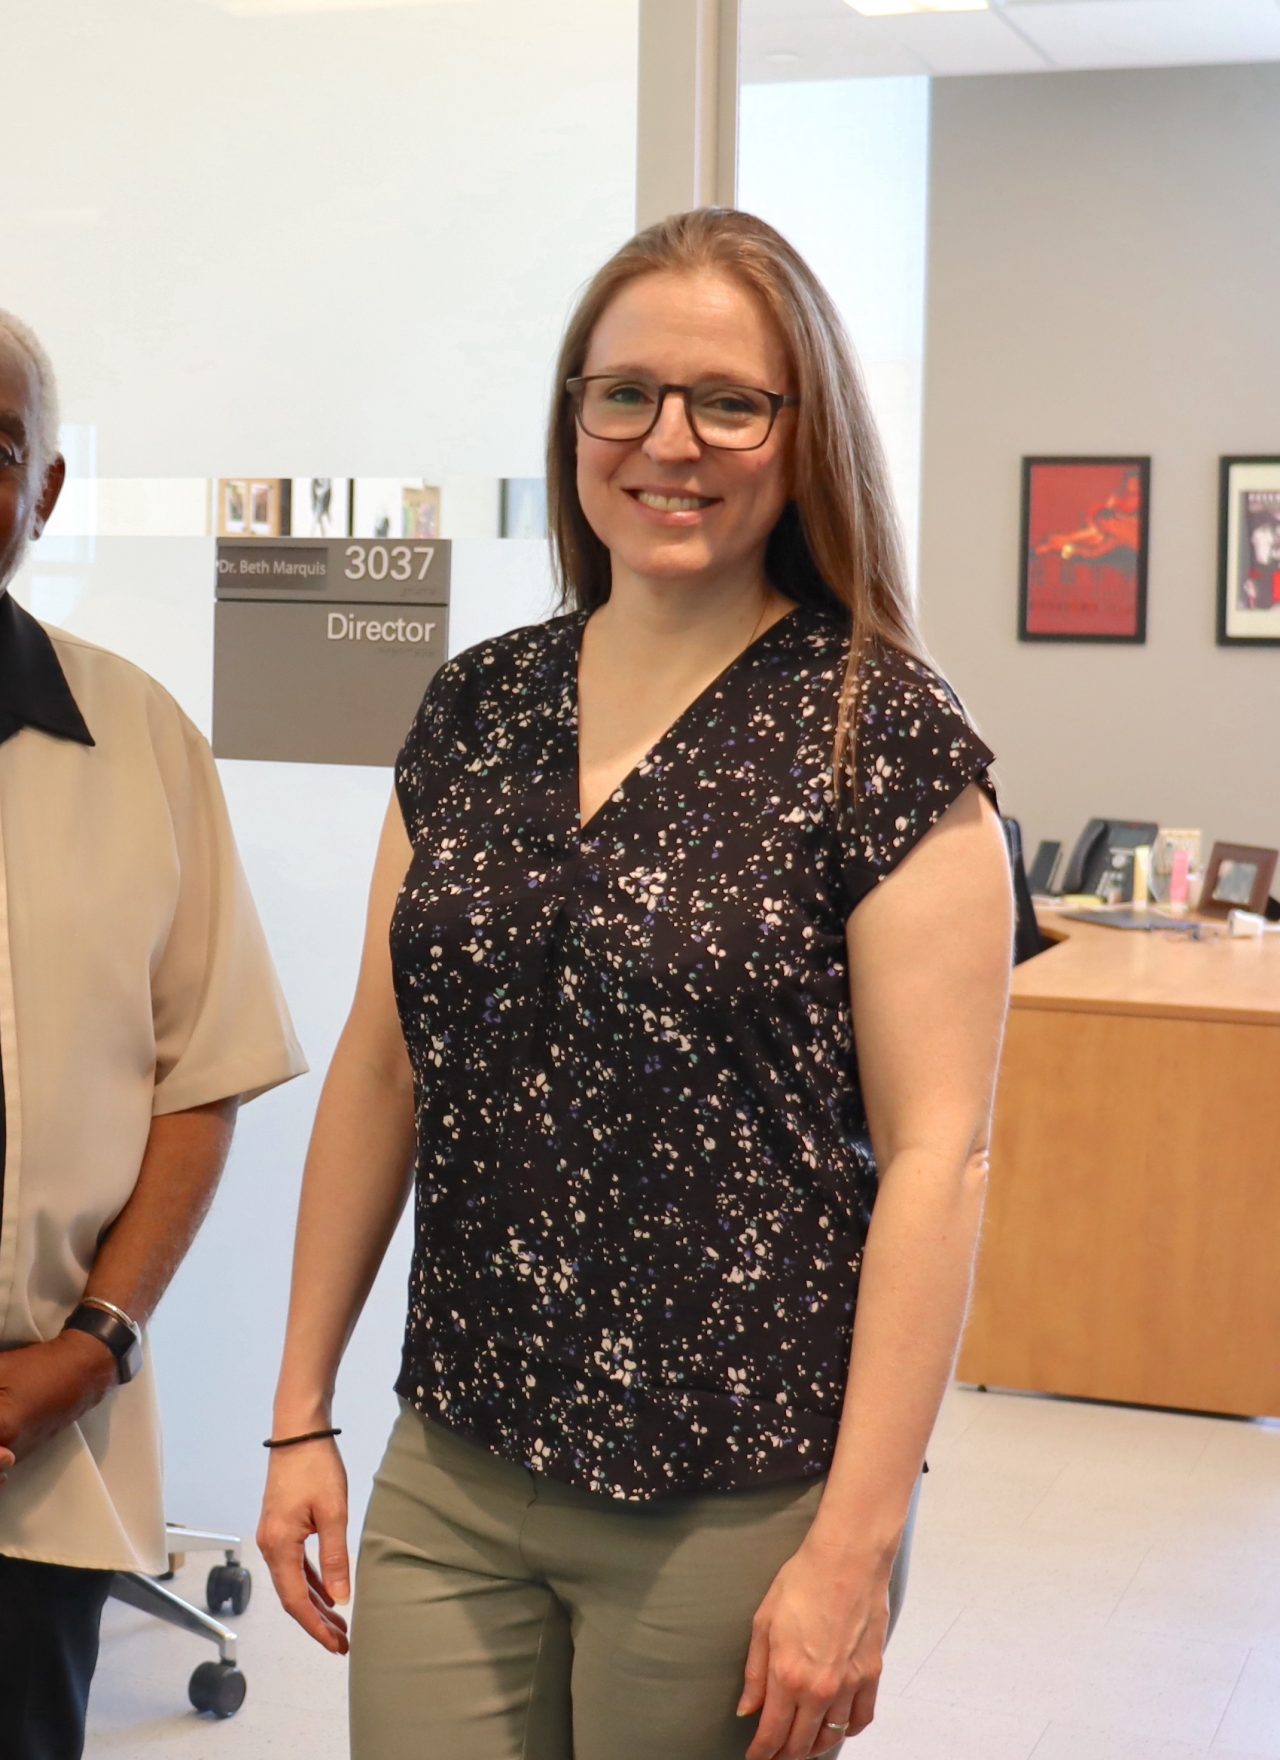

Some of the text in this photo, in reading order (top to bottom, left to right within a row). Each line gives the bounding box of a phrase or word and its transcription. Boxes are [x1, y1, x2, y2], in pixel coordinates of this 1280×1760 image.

[219, 559, 326, 578] Dr. Beth Marquis
[344, 545, 435, 581] 3037
[327, 612, 436, 642] Director
